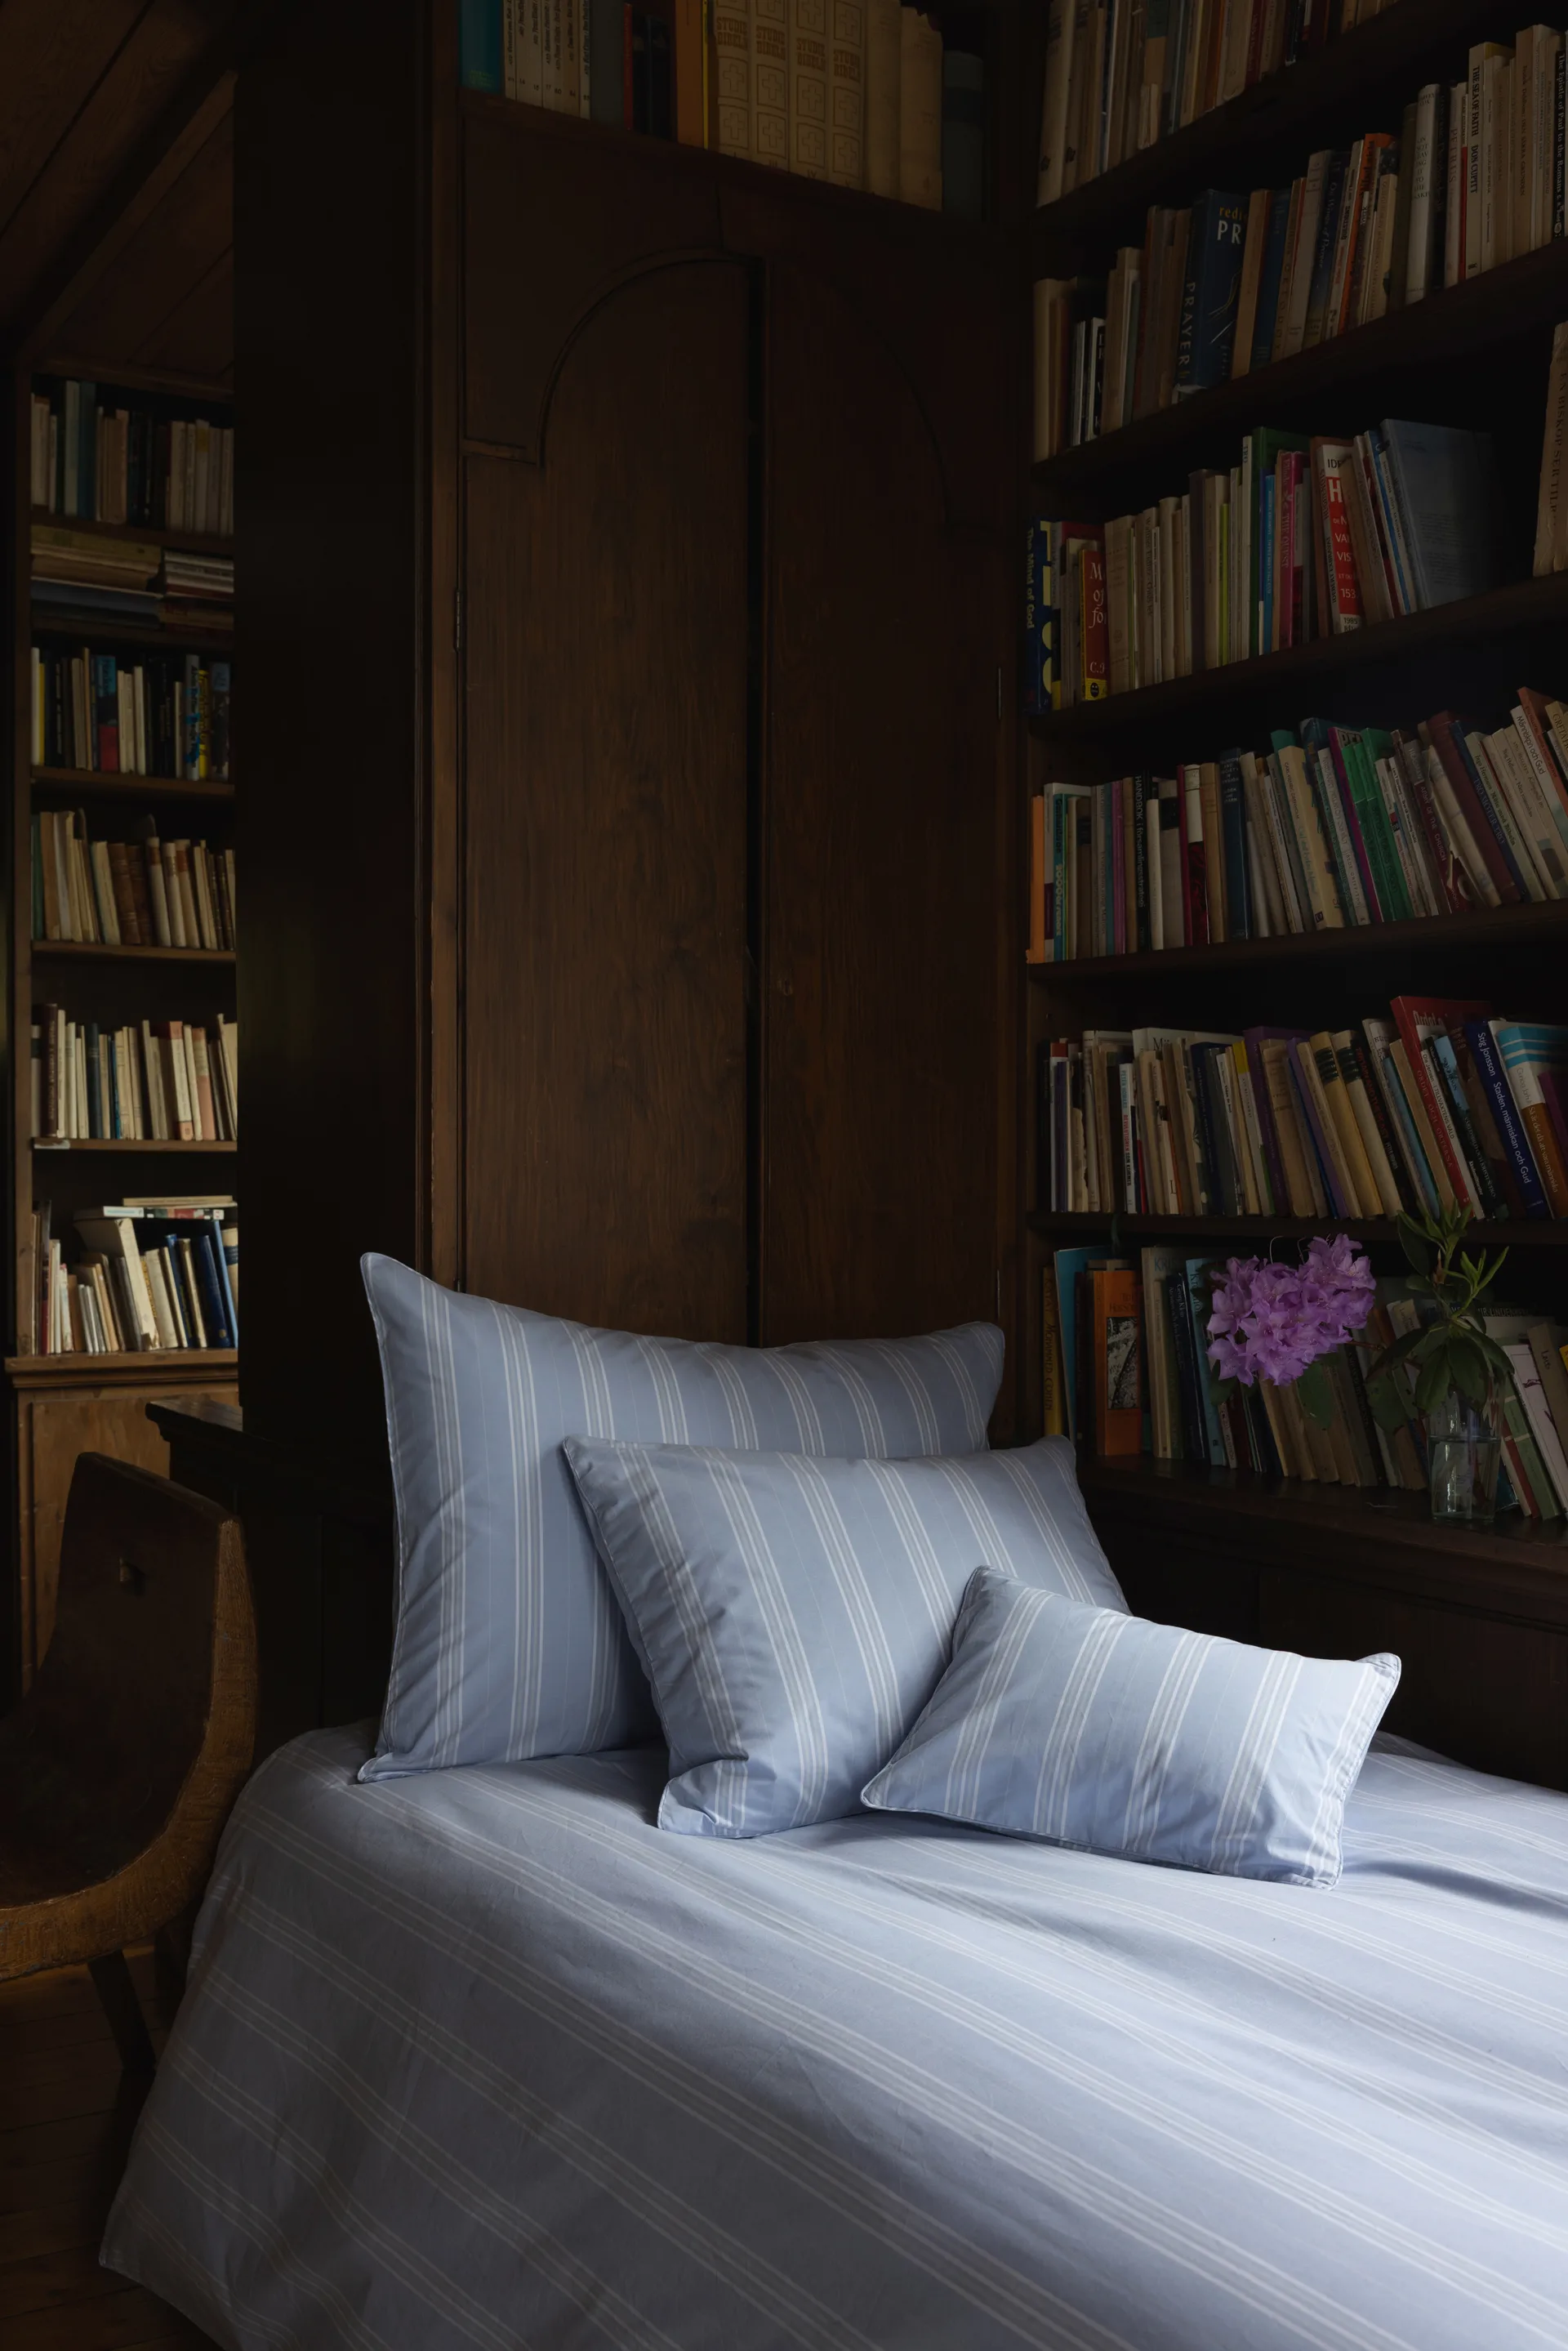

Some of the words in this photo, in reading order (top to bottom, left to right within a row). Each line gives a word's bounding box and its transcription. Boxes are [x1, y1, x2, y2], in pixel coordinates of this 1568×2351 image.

[755, 25, 786, 46] STUDIE
[795, 38, 825, 57] STUDIE
[1472, 84, 1480, 99] SEA
[1557, 72, 1565, 98] Epistle
[1472, 100, 1480, 110] OF
[1557, 101, 1565, 109] of
[1557, 133, 1564, 141] to
[1448, 128, 1459, 184] PETRUS
[1471, 145, 1479, 163] DON
[1470, 164, 1478, 194] CUPITT
[1178, 281, 1197, 365] PRAYER
[1560, 373, 1568, 391] EN
[1554, 396, 1566, 446] BISKOP
[1552, 450, 1561, 477] SER
[1281, 513, 1290, 533] THE
[1027, 528, 1035, 551] The
[1281, 536, 1290, 569] QUEST
[1027, 554, 1035, 584] Mind
[1027, 587, 1035, 600] of
[1027, 604, 1035, 630] God
[1514, 714, 1536, 750] Människan
[1529, 747, 1541, 761] och
[1534, 759, 1548, 775] Gud
[1135, 775, 1143, 820] HANDBOK
[1419, 786, 1431, 805] ARMY
[1434, 833, 1448, 862] CHURCH
[1472, 778, 1486, 796] TRO
[1493, 826, 1507, 845] TRO
[1135, 828, 1146, 908] församlingsstrategi
[1476, 1031, 1489, 1048] Stig
[1481, 1046, 1499, 1077] Jonsson
[1415, 1069, 1430, 1098] ORDET
[1427, 1103, 1439, 1123] OCH
[1492, 1081, 1509, 1111] Staden,
[1501, 1109, 1521, 1149] människan
[1514, 1149, 1526, 1166] och
[1125, 1164, 1134, 1186] KOMMER
[1519, 1165, 1532, 1184] Gud
[1044, 1320, 1056, 1374] MOHAMMED
[1045, 1377, 1054, 1411] COHEN
